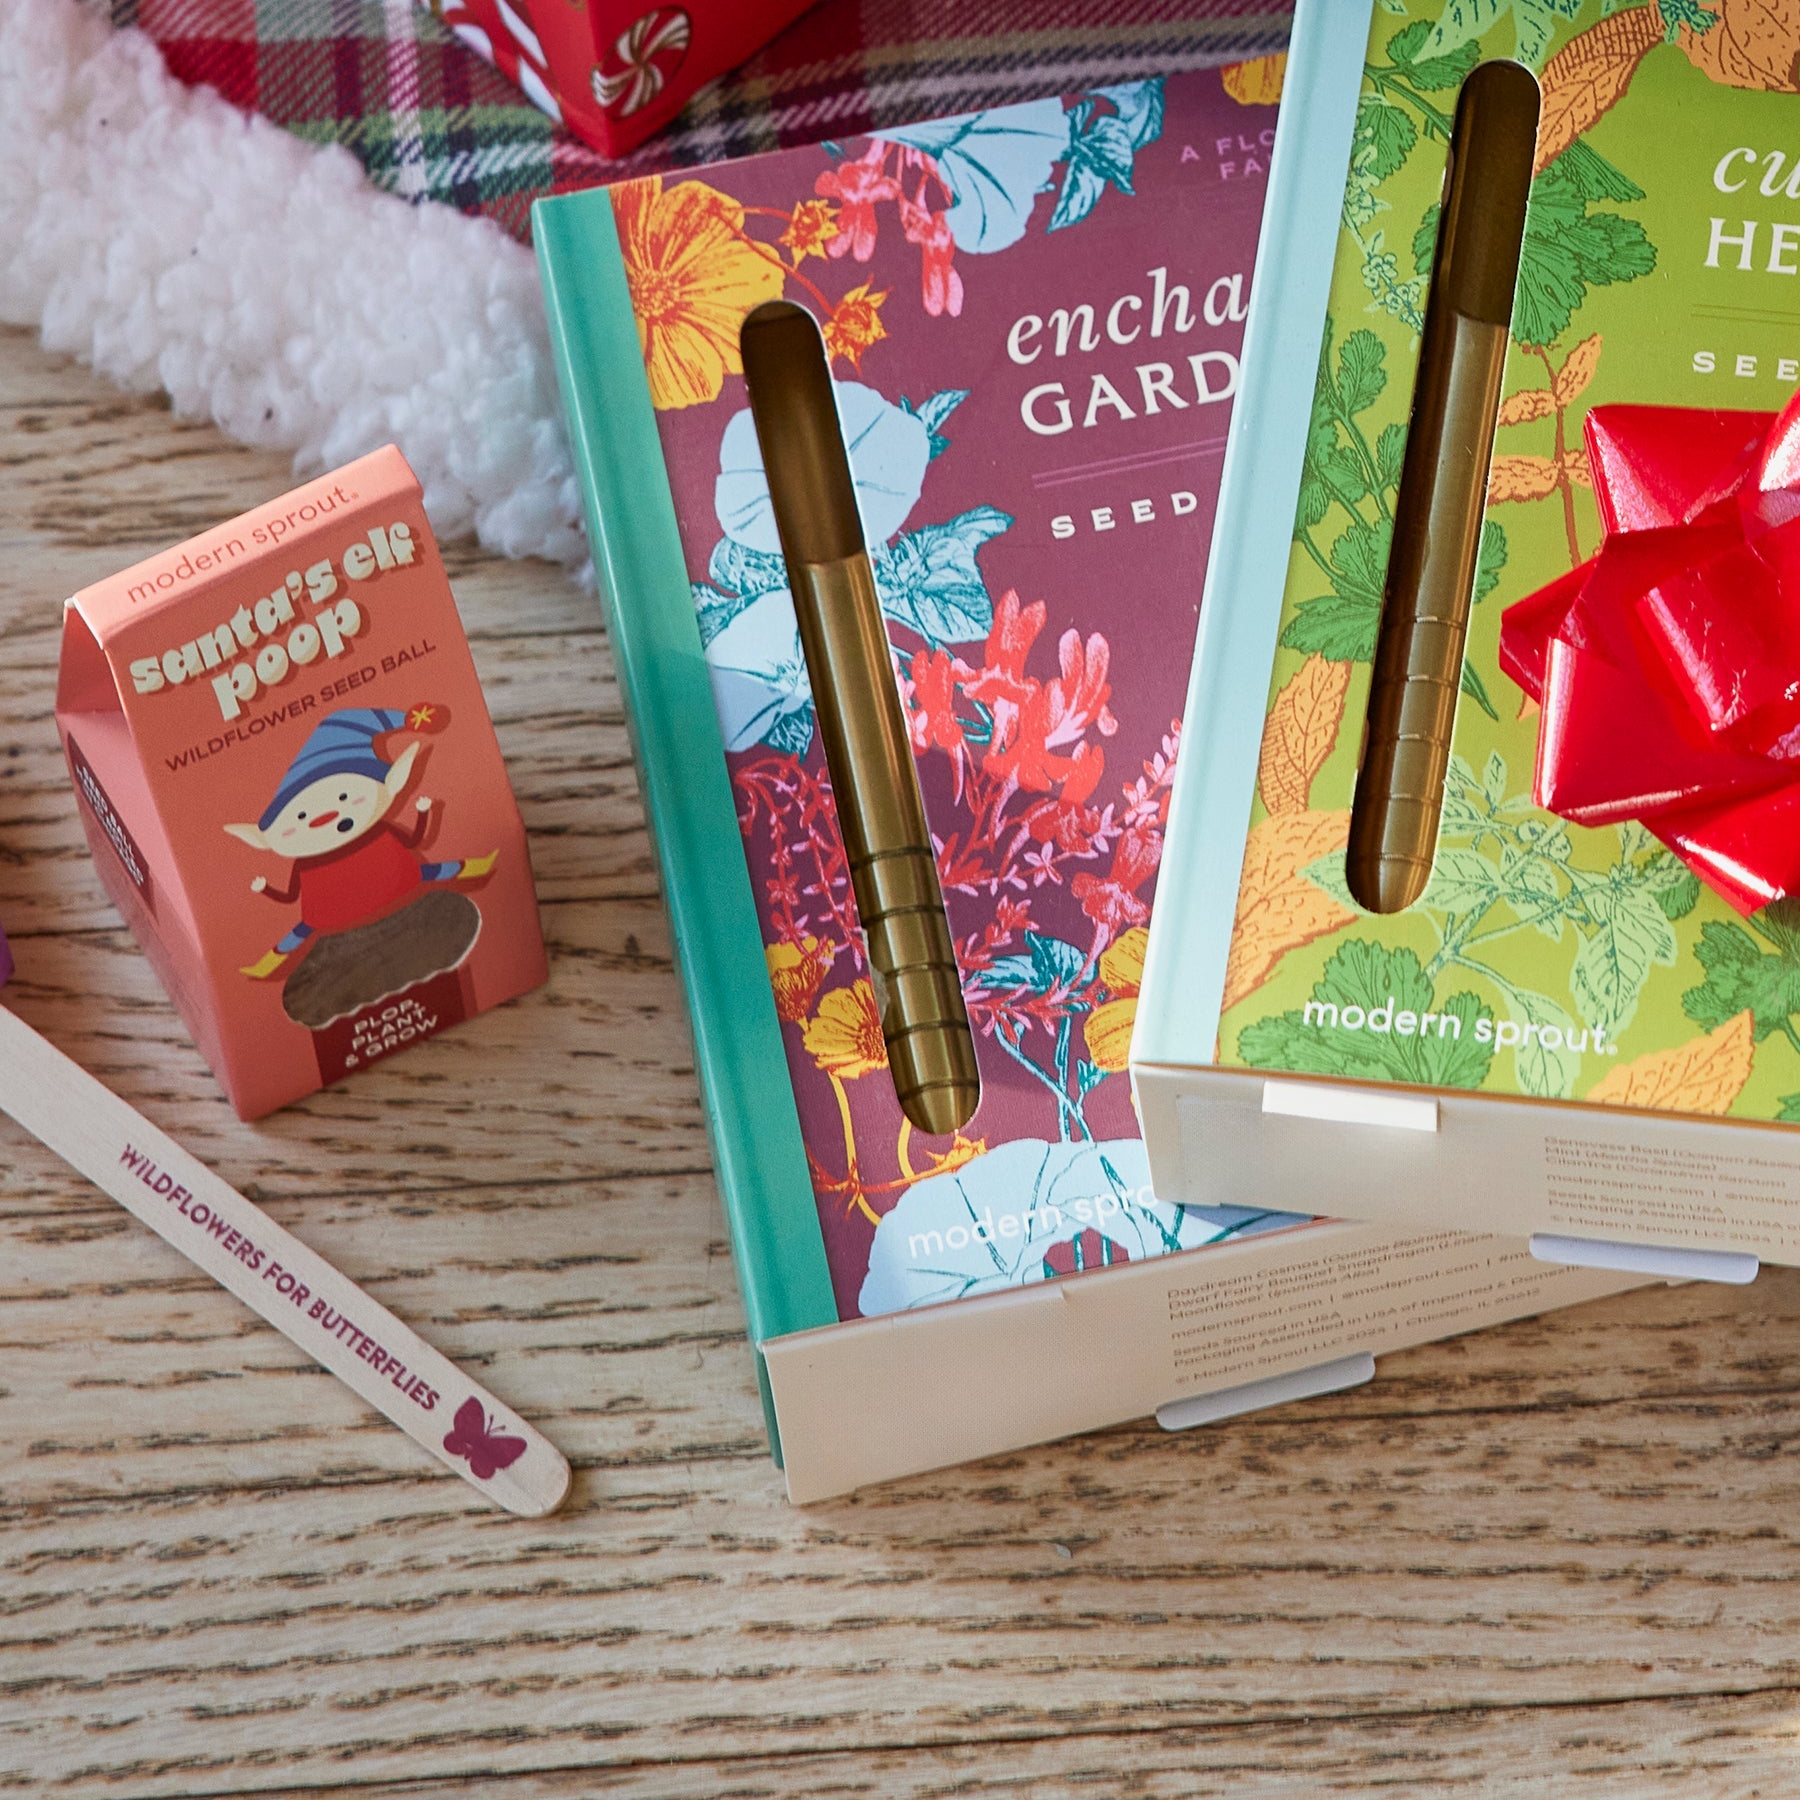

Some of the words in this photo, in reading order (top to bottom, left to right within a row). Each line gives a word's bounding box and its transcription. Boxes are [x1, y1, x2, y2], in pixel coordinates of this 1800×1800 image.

[1181, 145, 1200, 163] A
[1216, 129, 1275, 156] FLO
[1007, 266, 1249, 365] encha
[1020, 350, 1241, 436] GARD
[1691, 350, 1799, 381] SEE
[1050, 491, 1198, 539] SEED
[127, 533, 246, 604] modern
[128, 561, 343, 694] santa's
[342, 519, 418, 583] elf
[210, 598, 362, 721] poop
[163, 695, 316, 773] WILDFLOWER
[318, 666, 379, 702] SEED
[379, 639, 438, 675] BALL
[344, 1053, 360, 1068] &
[365, 1015, 440, 1061] GROW
[351, 1008, 426, 1052] PLANT
[1302, 996, 1462, 1040] modern
[908, 1204, 1063, 1258] modern
[1074, 1184, 1159, 1227] spro
[118, 1142, 266, 1271] WILDFLOWERS
[262, 1262, 311, 1308] FOR
[307, 1298, 441, 1411] BUTTERFLIES
[1512, 1262, 1579, 1286] Domesti
[1308, 1310, 1340, 1324] USA
